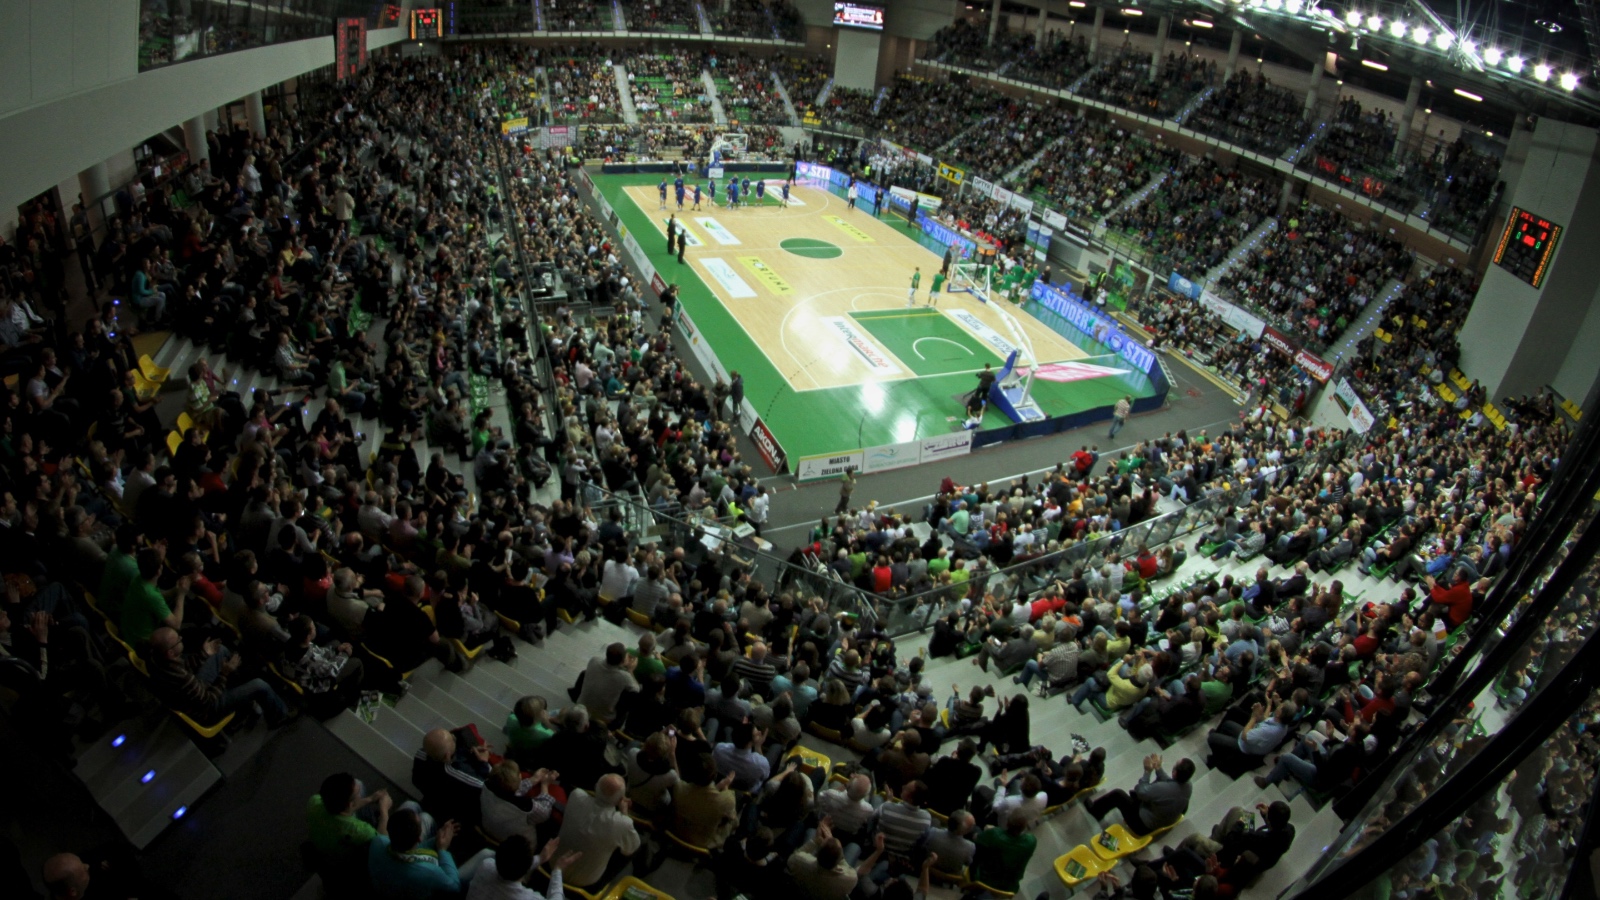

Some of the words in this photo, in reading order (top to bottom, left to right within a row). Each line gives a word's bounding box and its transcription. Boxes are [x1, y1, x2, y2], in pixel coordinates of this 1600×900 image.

[749, 258, 789, 291] FORTUNA
[829, 456, 850, 465] MIASTO
[821, 467, 843, 476] ZIELONA
